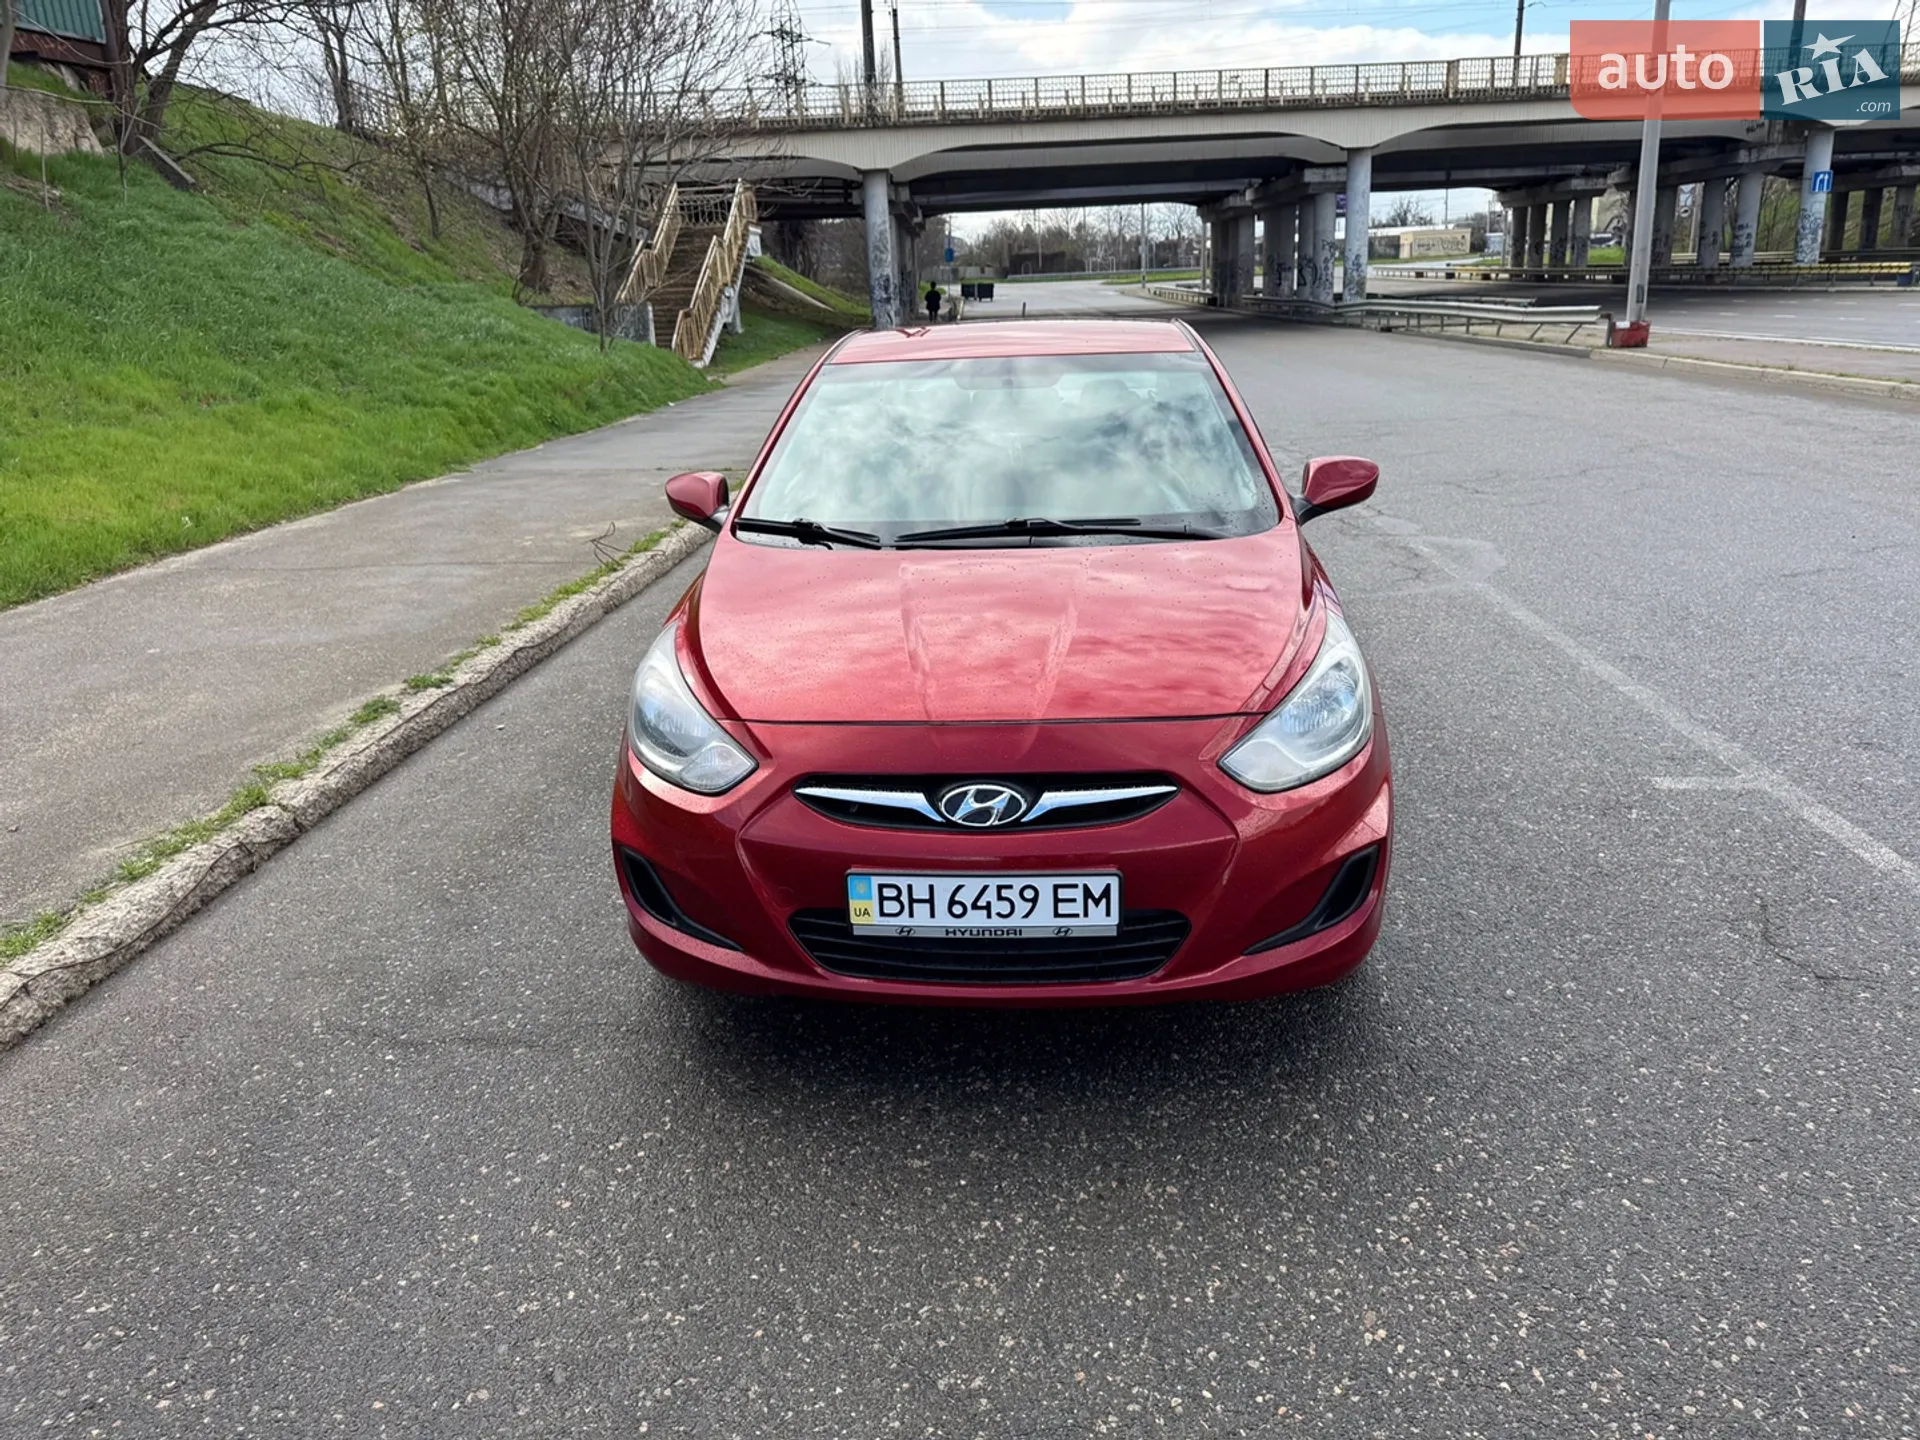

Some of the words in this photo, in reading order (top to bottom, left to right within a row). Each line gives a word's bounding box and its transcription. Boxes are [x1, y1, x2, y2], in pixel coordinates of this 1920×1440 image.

[877, 883, 936, 918] BH
[946, 884, 1040, 919] 6459
[1053, 883, 1112, 918] EM
[854, 907, 871, 918] UA
[945, 928, 1023, 936] HYUNDAI
